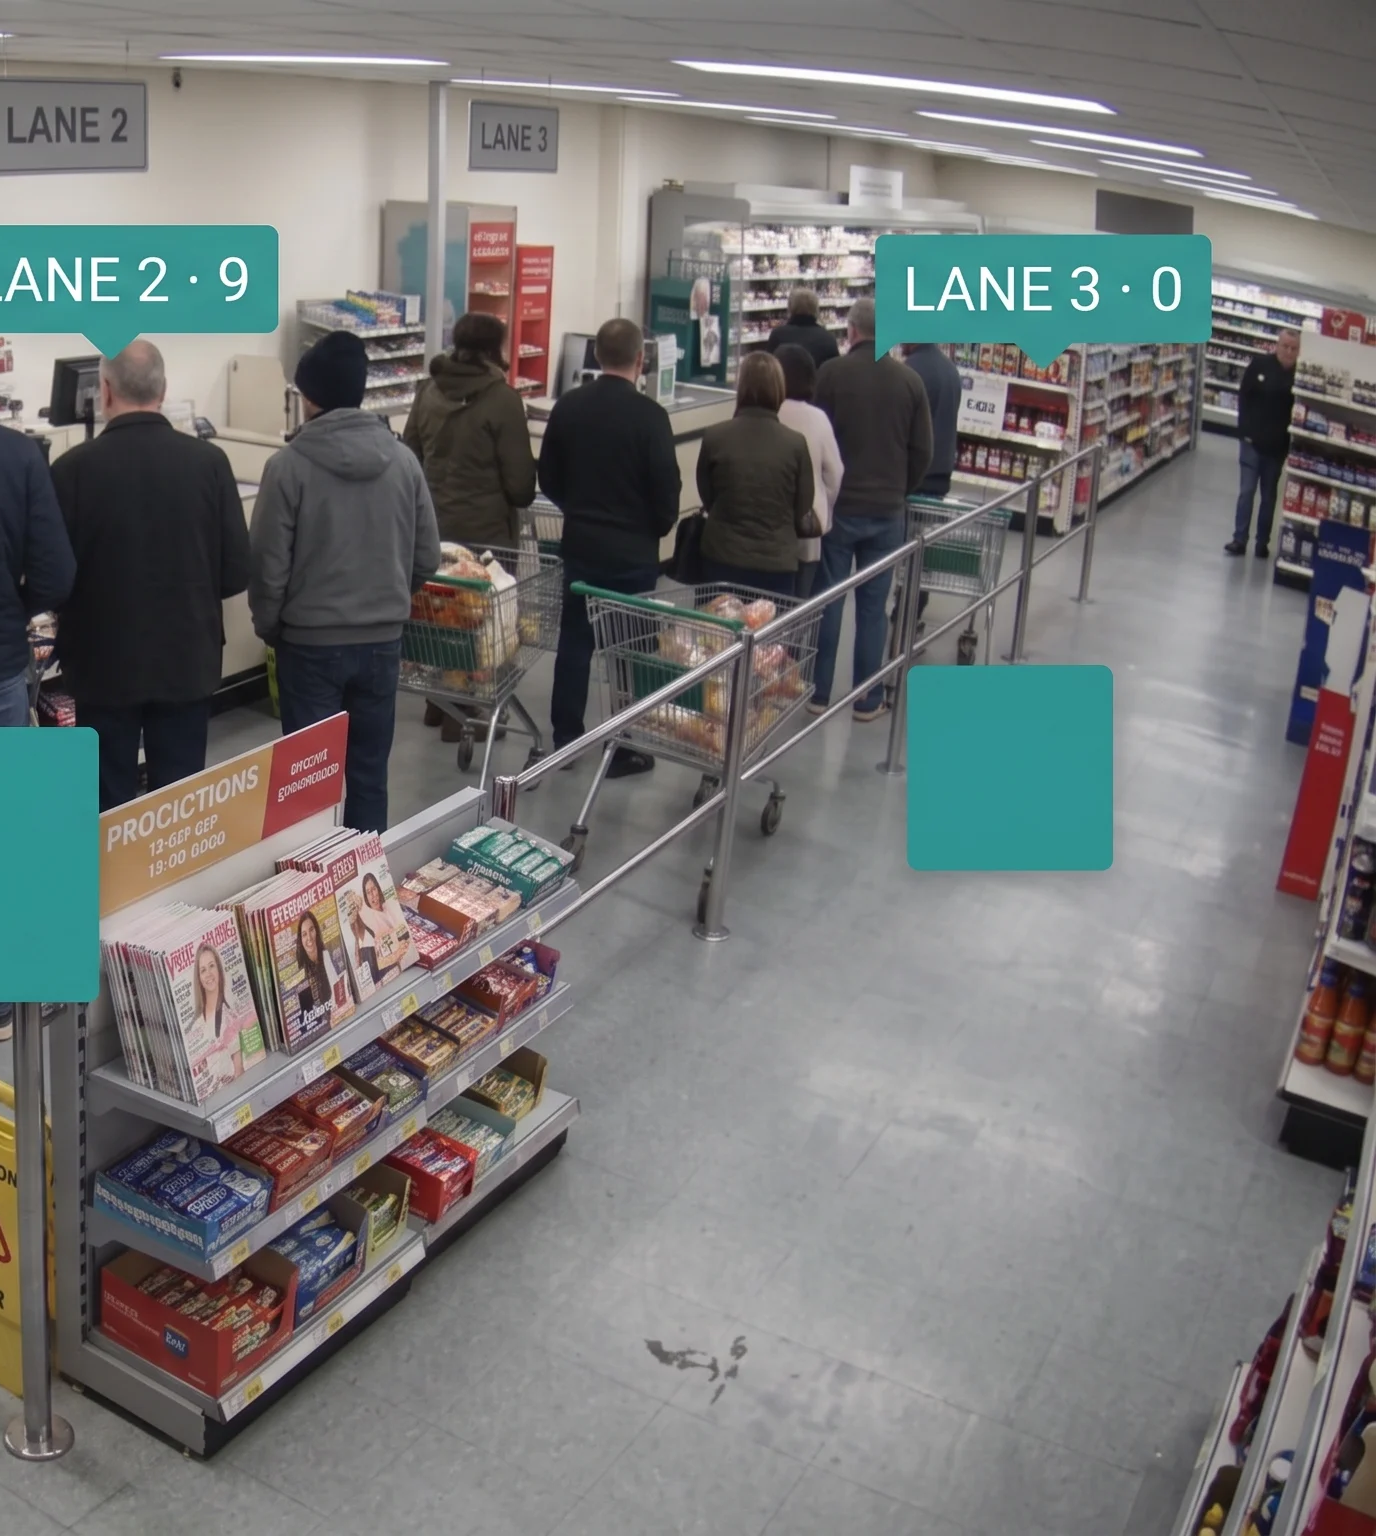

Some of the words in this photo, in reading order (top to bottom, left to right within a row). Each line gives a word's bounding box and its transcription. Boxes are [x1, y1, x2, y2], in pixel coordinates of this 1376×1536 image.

[7, 106, 100, 144] LANE
[111, 107, 128, 143] 2
[481, 122, 532, 151] LANE
[537, 125, 548, 153] 3
[106, 764, 259, 853] PROCICTIONS
